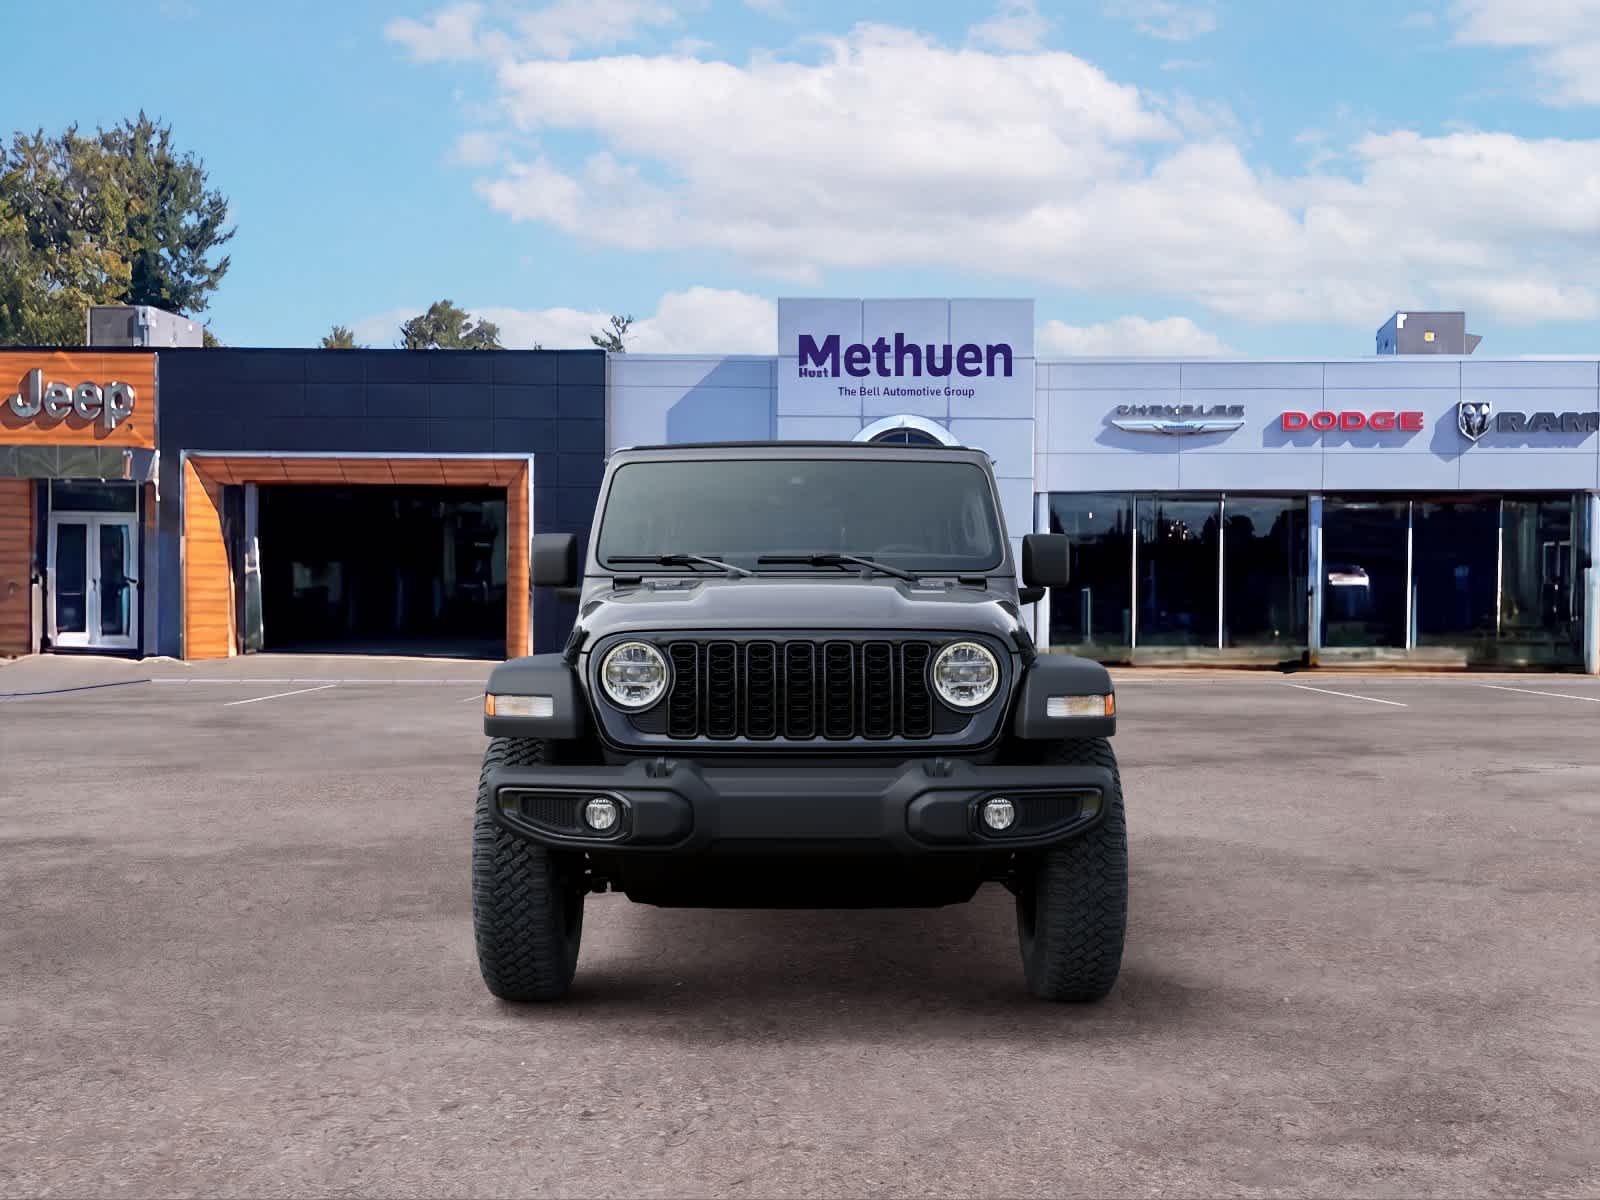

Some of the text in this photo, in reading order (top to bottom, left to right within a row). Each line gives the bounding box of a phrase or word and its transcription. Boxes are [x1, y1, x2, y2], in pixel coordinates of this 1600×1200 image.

[798, 333, 1013, 377] Methuen
[8, 367, 136, 431] Jeep
[838, 386, 975, 399] The Bell Automotive Group
[1281, 411, 1424, 432] DODGE
[1497, 412, 1599, 433] RAM
